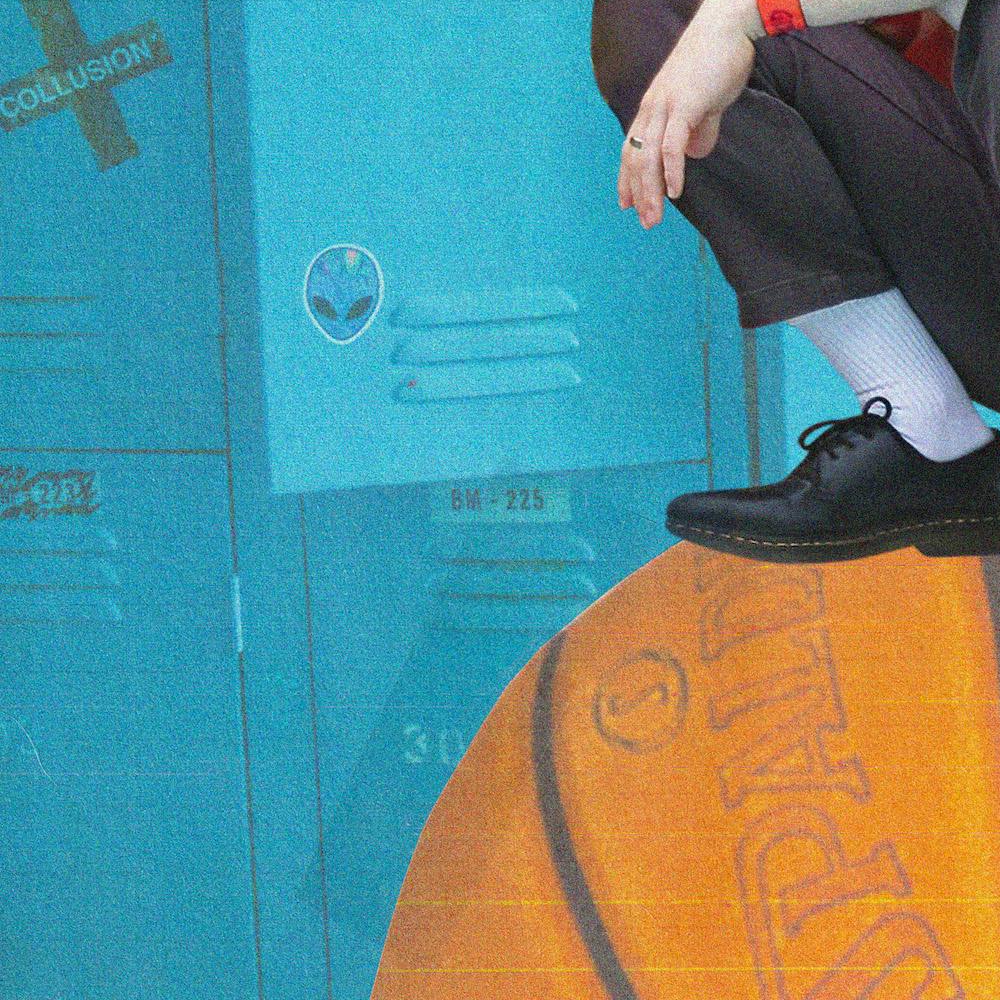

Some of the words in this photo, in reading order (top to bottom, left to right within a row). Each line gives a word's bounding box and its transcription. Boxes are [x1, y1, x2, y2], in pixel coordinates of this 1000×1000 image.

[0, 38, 153, 118] COLLUSION
[451, 488, 482, 512] BM
[506, 488, 545, 512] 225
